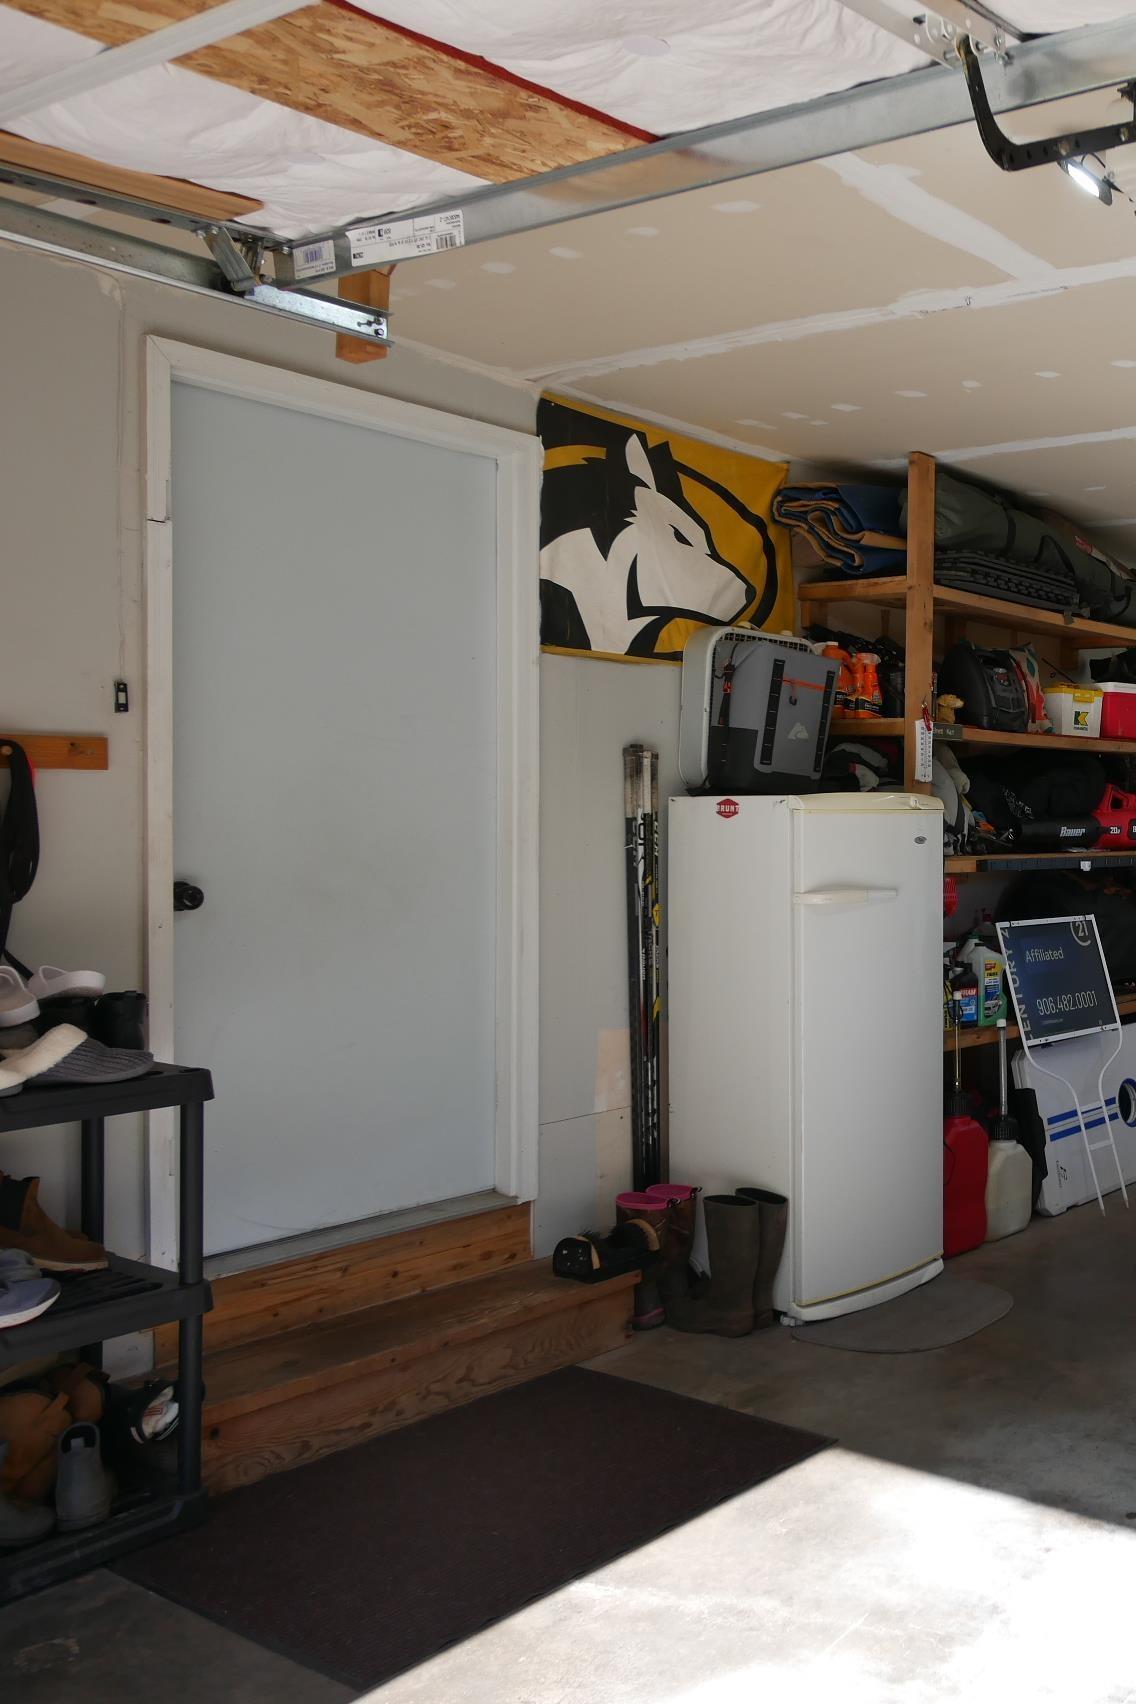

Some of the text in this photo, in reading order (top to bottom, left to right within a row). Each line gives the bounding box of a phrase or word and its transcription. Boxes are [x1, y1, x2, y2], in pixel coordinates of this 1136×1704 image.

[1060, 826, 1086, 837] Bauer
[1025, 946, 1065, 963] Affiliated
[1036, 989, 1099, 1015] 906.482.0001
